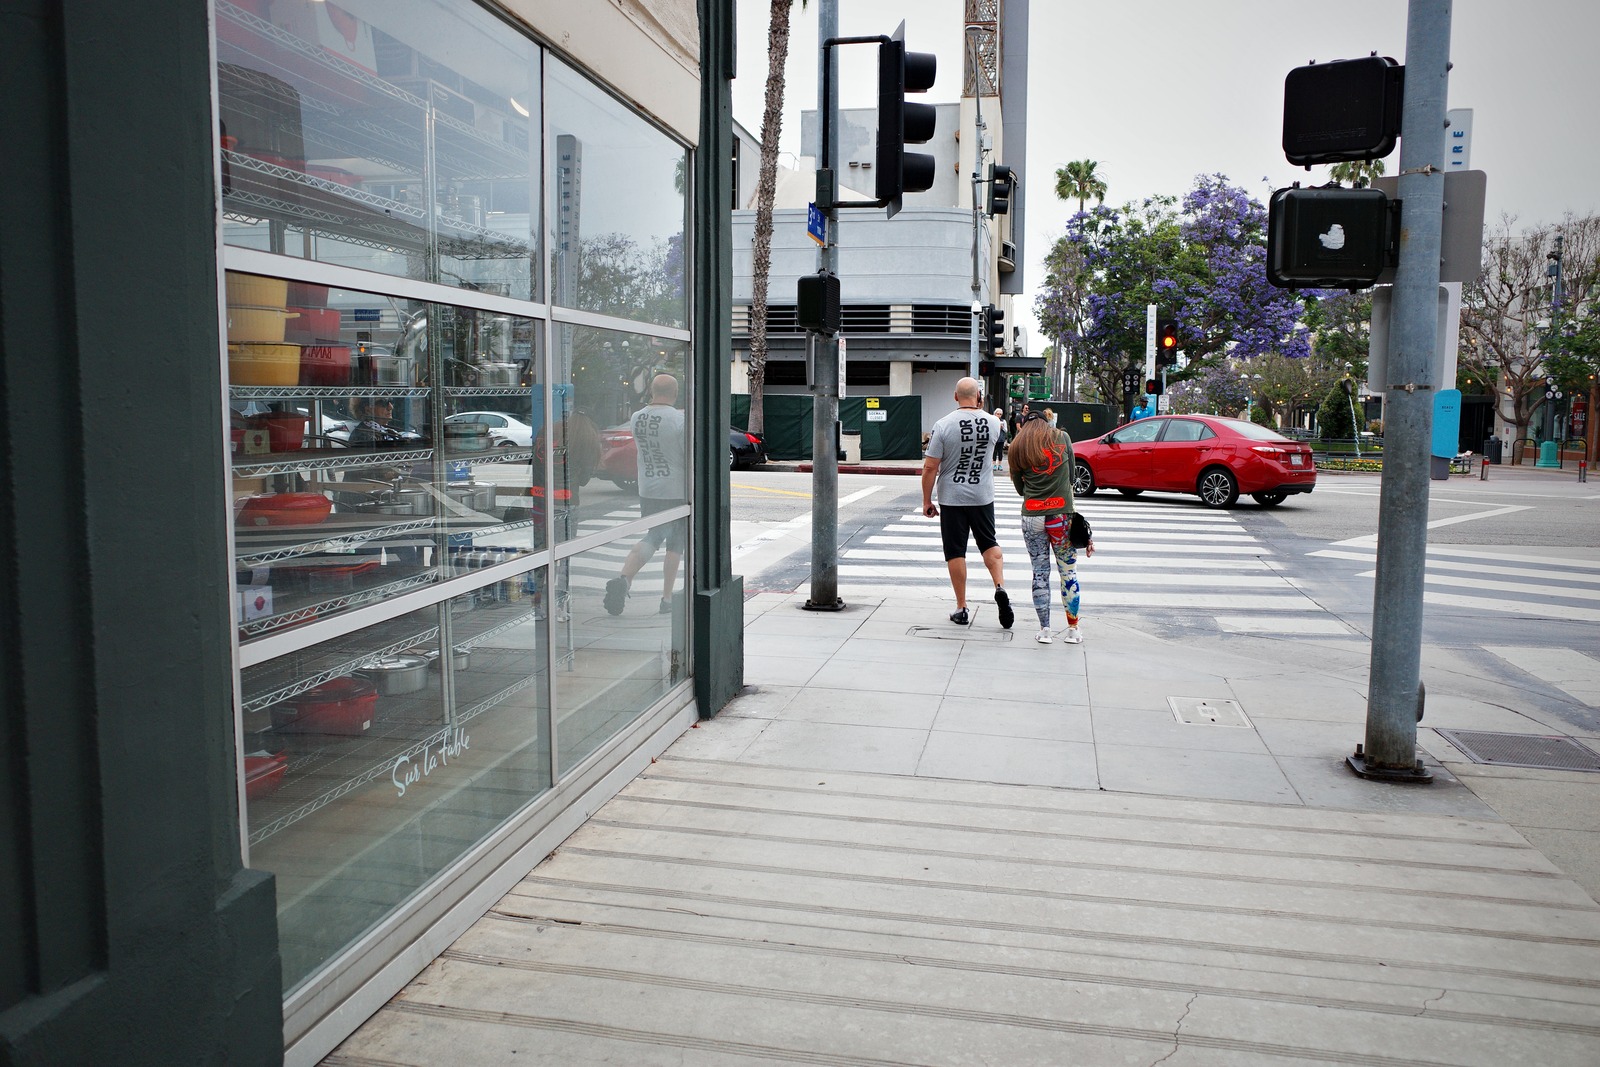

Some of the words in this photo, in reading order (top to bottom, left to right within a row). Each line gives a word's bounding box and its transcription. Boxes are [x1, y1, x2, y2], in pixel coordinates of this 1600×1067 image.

[959, 419, 974, 442] FOR
[968, 417, 989, 484] GREATNESS
[953, 442, 972, 484] STRIVE
[392, 756, 420, 797] Sur
[424, 747, 438, 776] la
[438, 728, 470, 766] table
